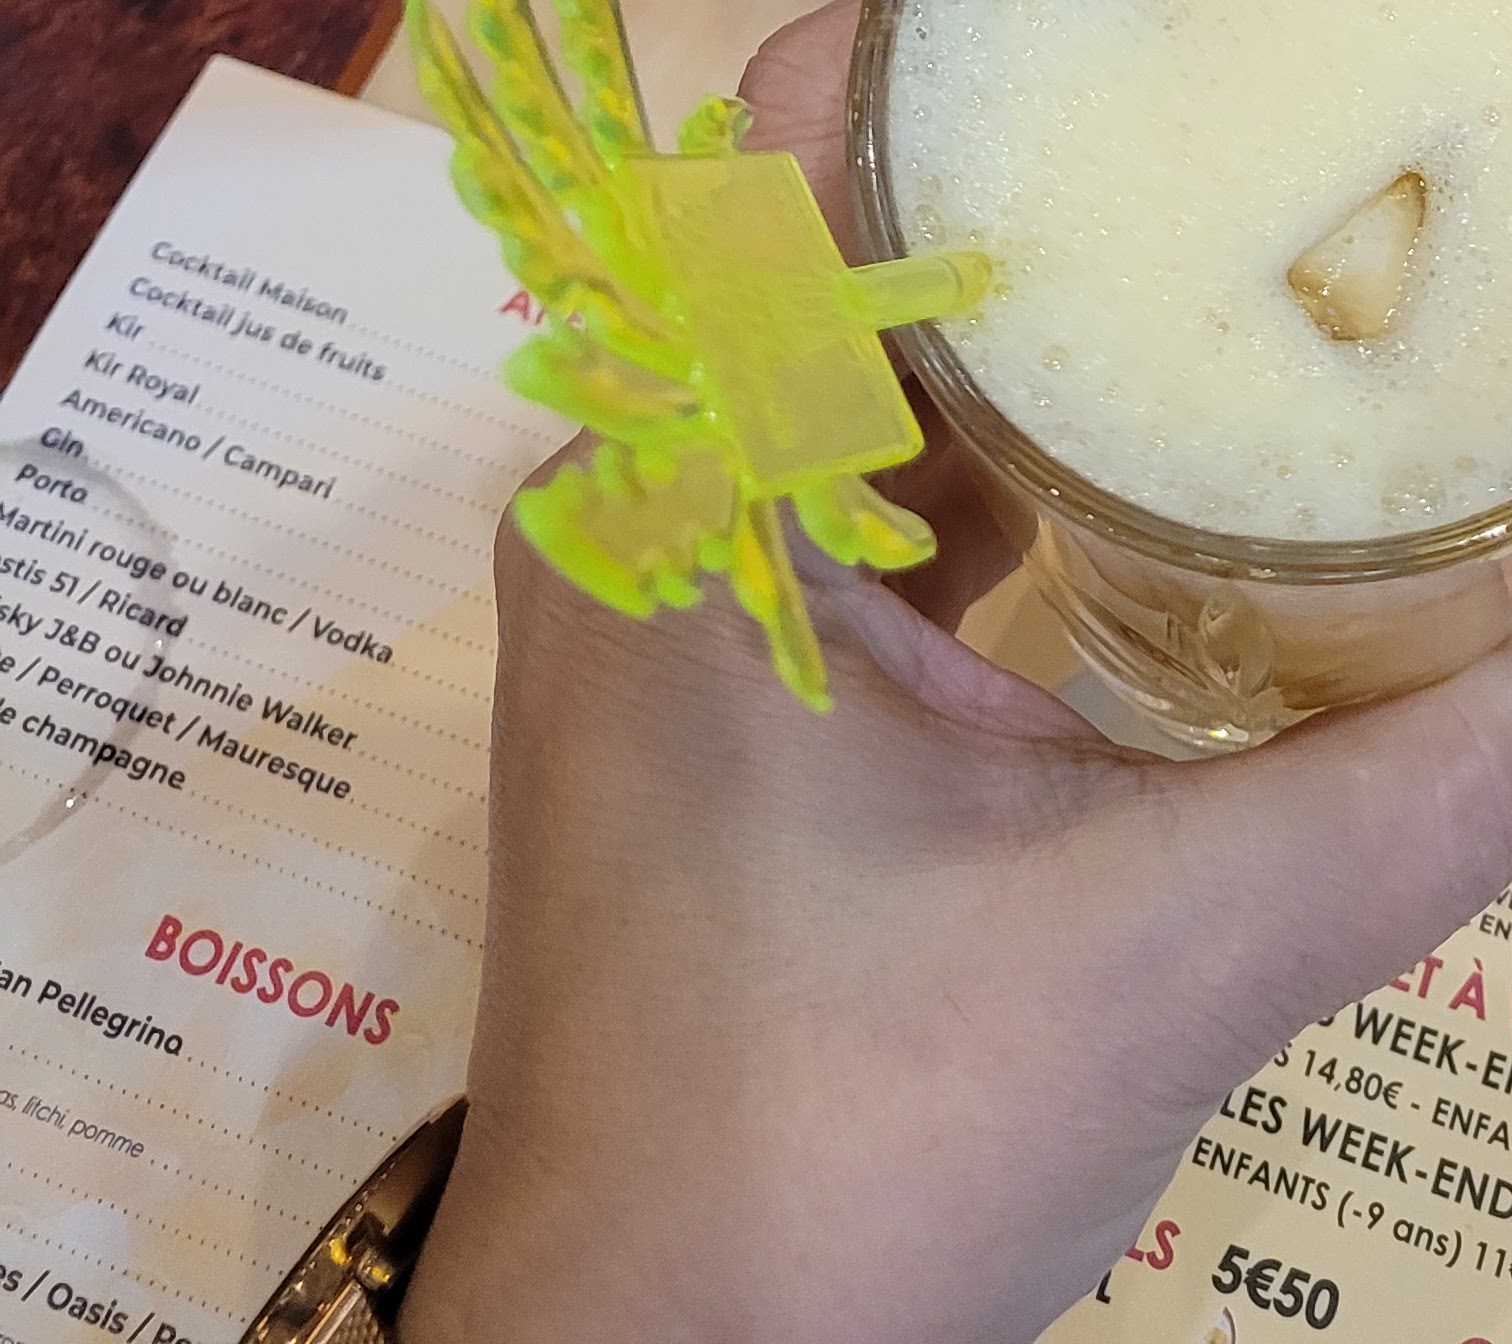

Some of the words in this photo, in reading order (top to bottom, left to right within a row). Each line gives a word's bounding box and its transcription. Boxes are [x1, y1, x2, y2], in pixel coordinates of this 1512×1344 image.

[151, 241, 256, 292] Cocktail
[260, 278, 349, 325] Maison
[106, 311, 146, 341] Kir
[129, 276, 236, 328] Cocktail
[231, 313, 278, 343] jus
[280, 329, 314, 357] de
[317, 342, 389, 382] fruits
[84, 347, 125, 378] Kir
[126, 362, 200, 407] Royal
[15, 462, 89, 505] Porto
[40, 426, 86, 459] Gin
[60, 387, 201, 453] Americano
[202, 434, 227, 460] /
[223, 444, 339, 500] Campari
[0, 501, 89, 553] Martini
[88, 539, 167, 581] rouge
[172, 569, 209, 596] ou
[212, 580, 289, 626] blanc
[287, 607, 312, 633] /
[313, 614, 394, 665] Vodka
[0, 553, 47, 586] stis
[50, 571, 79, 598] 51
[77, 578, 104, 606] /
[99, 588, 190, 638] Ricard
[0, 596, 44, 636] sky
[44, 618, 102, 655] J&B
[104, 645, 143, 671] ou
[143, 653, 254, 712] Johnnie
[262, 695, 358, 751] Walker
[21, 713, 187, 792] champagne
[37, 664, 178, 736] Perroquet
[175, 714, 202, 743] /
[197, 723, 353, 800] Mauresque
[0, 962, 33, 999] an
[37, 978, 184, 1057] Pellegrino
[144, 912, 401, 1046] BOISSONS
[1448, 956, 1487, 1021] À
[1219, 1085, 1288, 1136] LES
[1303, 1048, 1404, 1111] 14,80€
[67, 1117, 146, 1159] pomme
[1191, 1135, 1332, 1212] ENFANTS
[1336, 1190, 1386, 1230] (-9
[1393, 1217, 1464, 1269] ans)
[21, 1269, 51, 1303] /
[46, 1282, 129, 1336] Oasis
[1211, 1244, 1341, 1331] 5€50
